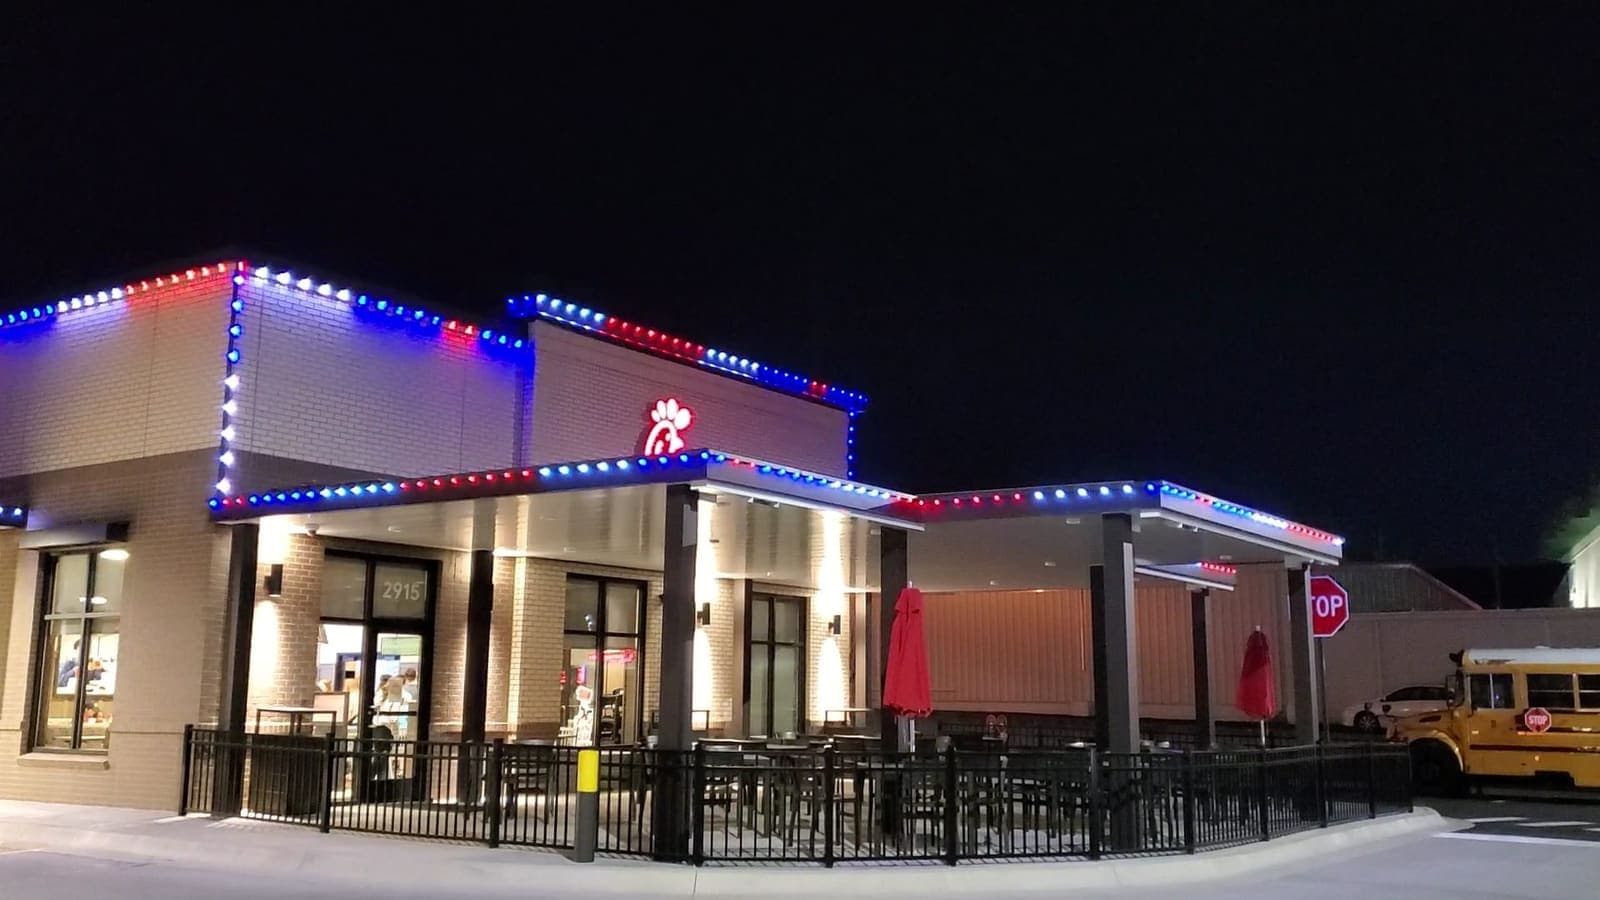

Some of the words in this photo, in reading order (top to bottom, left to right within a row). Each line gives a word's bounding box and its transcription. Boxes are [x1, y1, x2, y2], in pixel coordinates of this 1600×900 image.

[382, 581, 420, 601] 2915
[1311, 595, 1343, 617] OP
[1528, 715, 1548, 725] STOP
